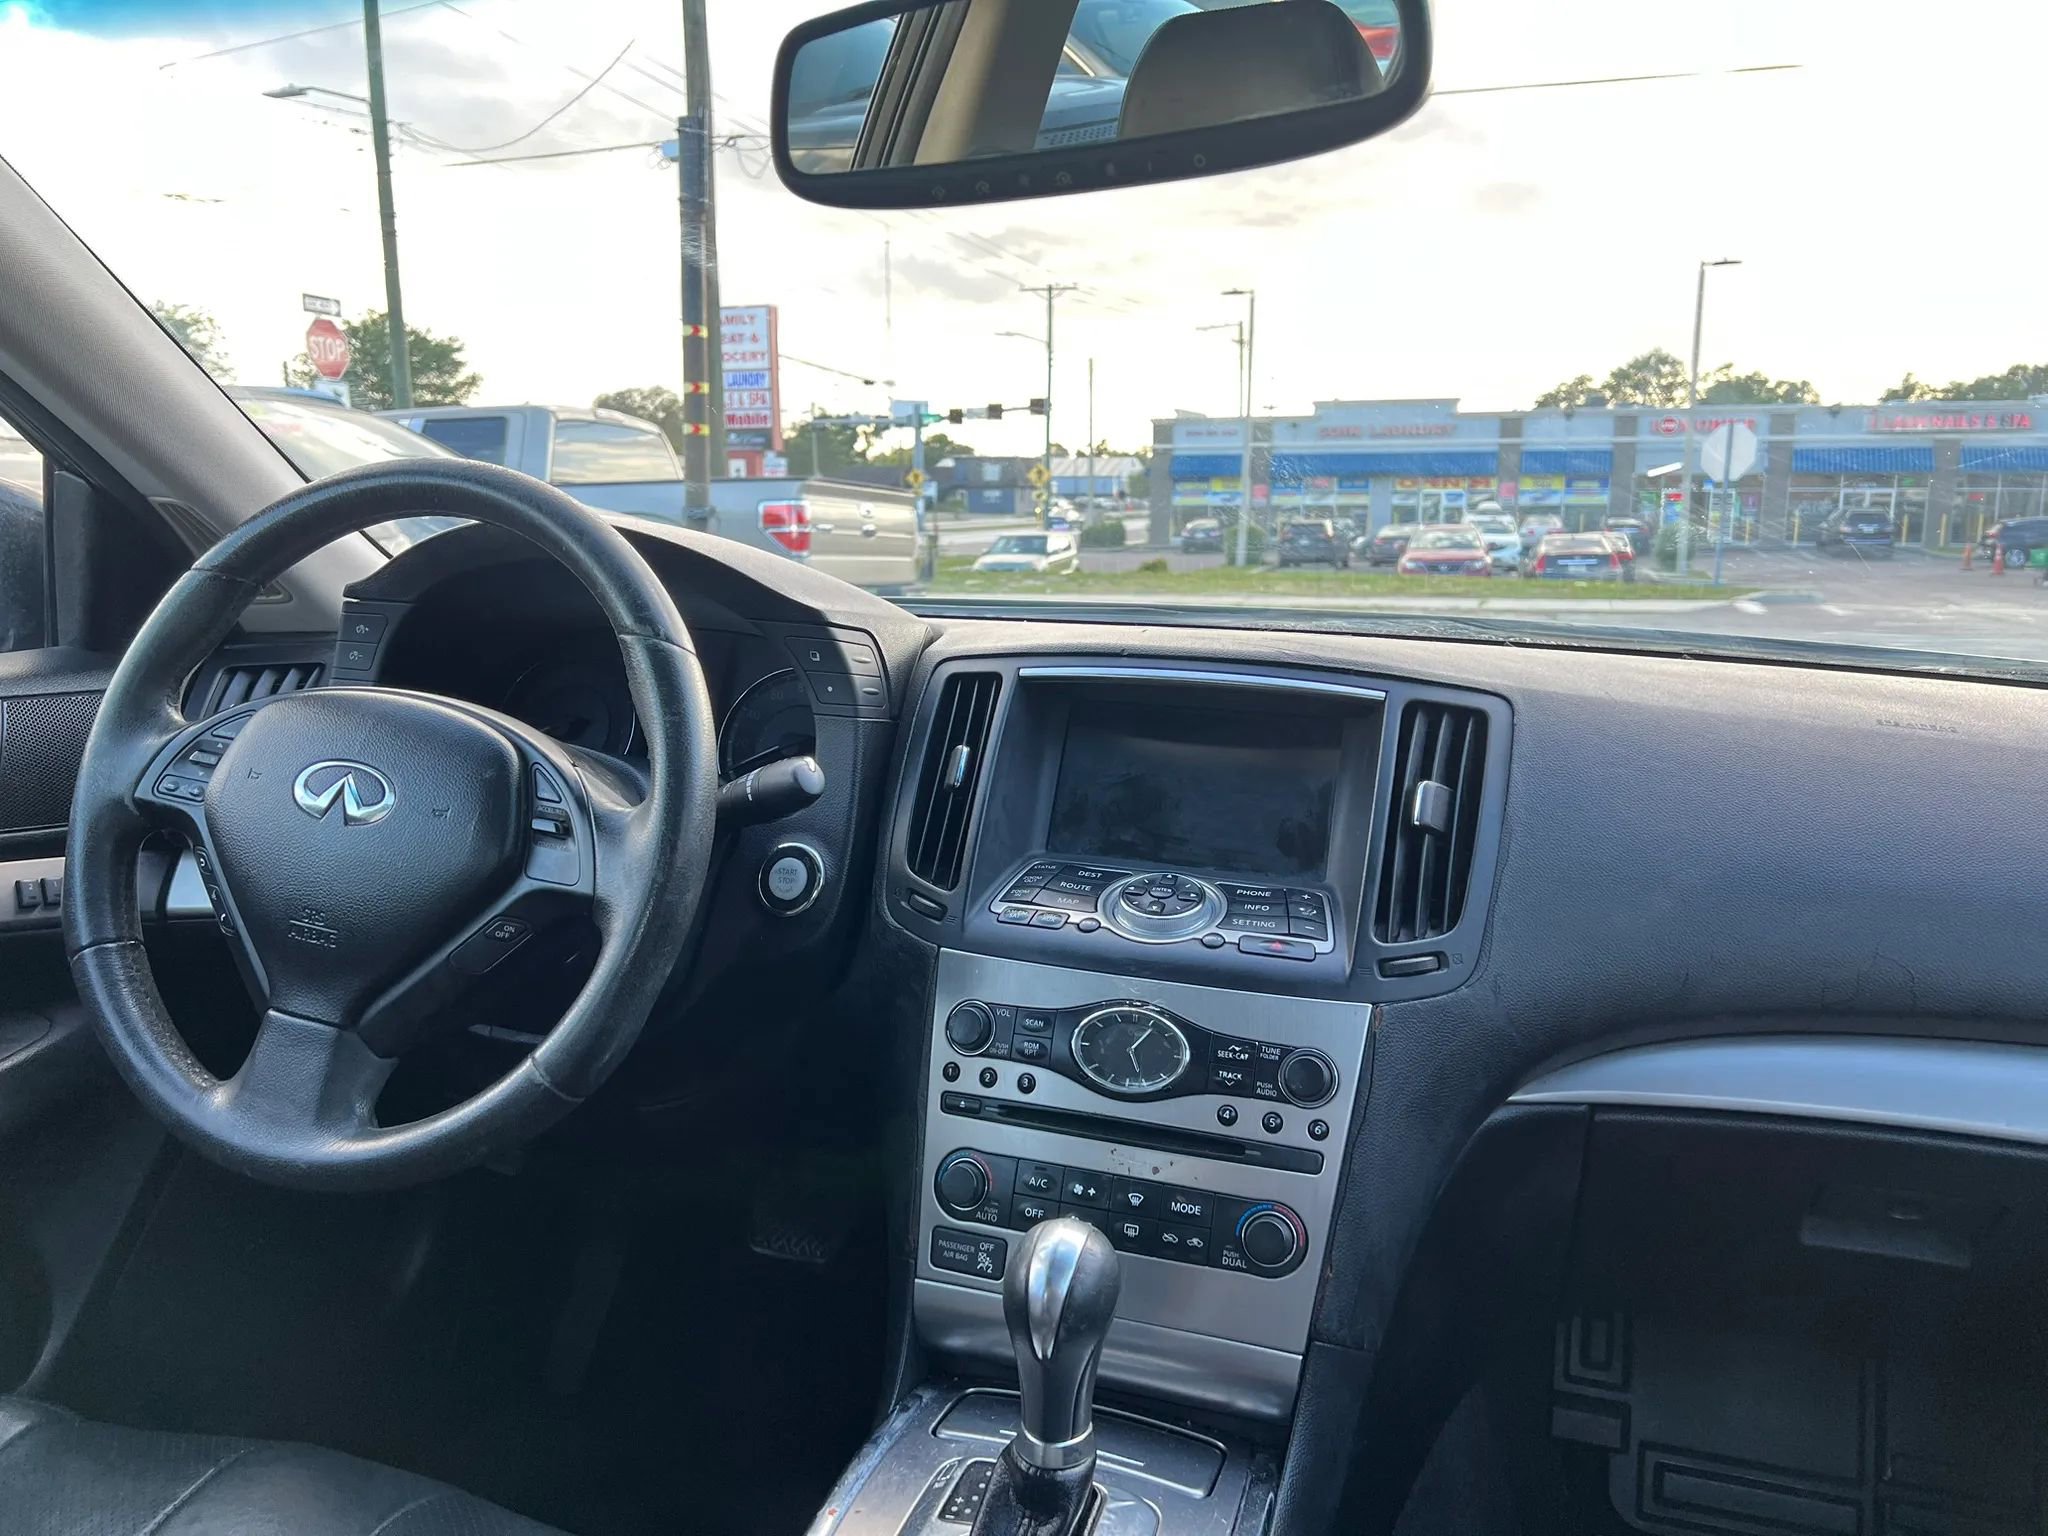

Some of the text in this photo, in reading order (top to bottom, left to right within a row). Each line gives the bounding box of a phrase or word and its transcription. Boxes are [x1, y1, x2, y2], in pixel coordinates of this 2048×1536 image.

[309, 335, 347, 361] STOP
[1077, 870, 1103, 879] DEST
[1060, 881, 1093, 892] ROUTE
[1236, 889, 1272, 897] PHONE
[1057, 897, 1080, 905] MAP
[1244, 904, 1270, 912] INFO
[1232, 918, 1276, 928] SETTING
[503, 925, 516, 933] ON
[495, 930, 510, 939] OFF
[996, 1008, 1011, 1017] VOL
[1025, 1018, 1044, 1028] SCAN
[995, 1041, 1009, 1049] PUSH
[1023, 1041, 1040, 1050] RDM
[1024, 1048, 1038, 1057] RPT
[1261, 1045, 1281, 1056] TUNE
[1260, 1052, 1279, 1061] FOLDER
[1218, 1070, 1243, 1081] TRACK
[1022, 1078, 1029, 1088] 3
[1256, 1081, 1273, 1089] PUSH
[1256, 1087, 1278, 1097] AUDIO
[1223, 1109, 1230, 1119] 4
[1269, 1117, 1276, 1128] 5
[1314, 1125, 1322, 1135] 6
[1028, 1176, 1048, 1189] A/C
[1024, 1207, 1045, 1219] OFF
[1170, 1201, 1202, 1216] MODE
[975, 1210, 998, 1223] AUTO
[938, 1239, 976, 1253] PASSENGER
[979, 1242, 995, 1252] OFF
[943, 1250, 969, 1262] AIR BAG
[1223, 1249, 1240, 1258] PUSH
[1222, 1256, 1248, 1269] DUAL
